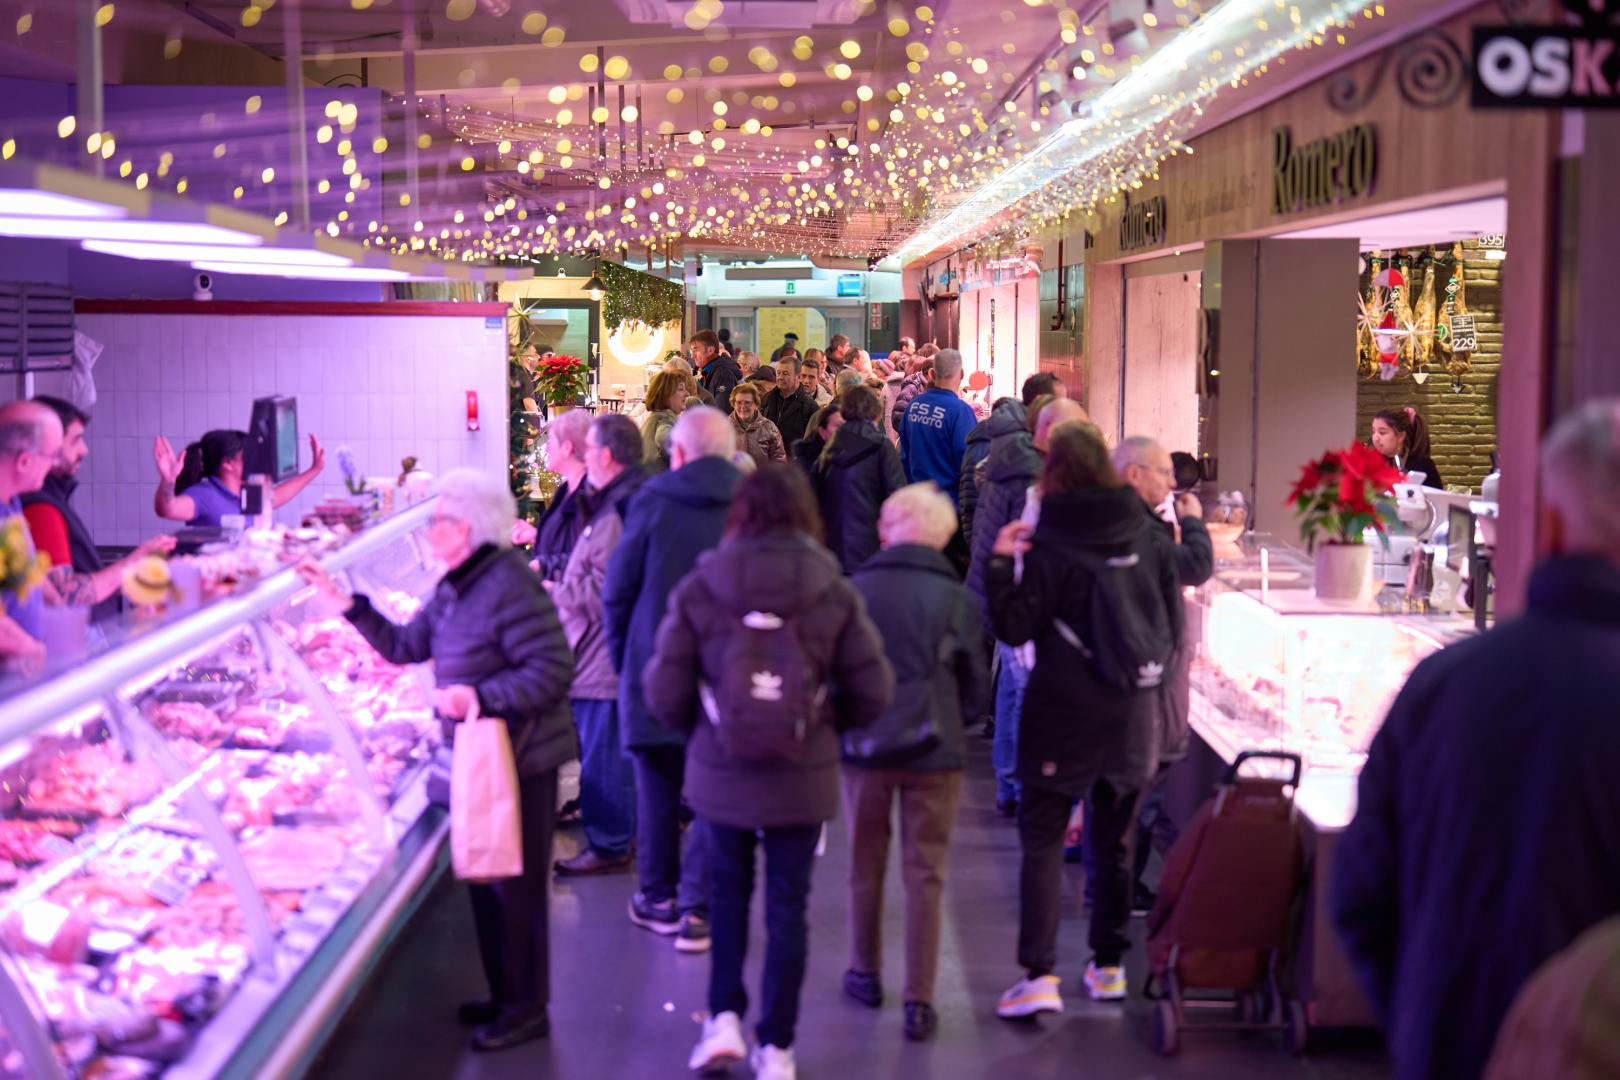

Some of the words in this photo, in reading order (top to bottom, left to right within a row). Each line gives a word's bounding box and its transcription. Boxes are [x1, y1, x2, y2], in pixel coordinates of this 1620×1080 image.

[1477, 35, 1620, 98] OSK
[1272, 123, 1375, 214] Romero
[1120, 190, 1166, 250] Romero
[1480, 231, 1502, 245] 395
[1453, 337, 1475, 350] 229
